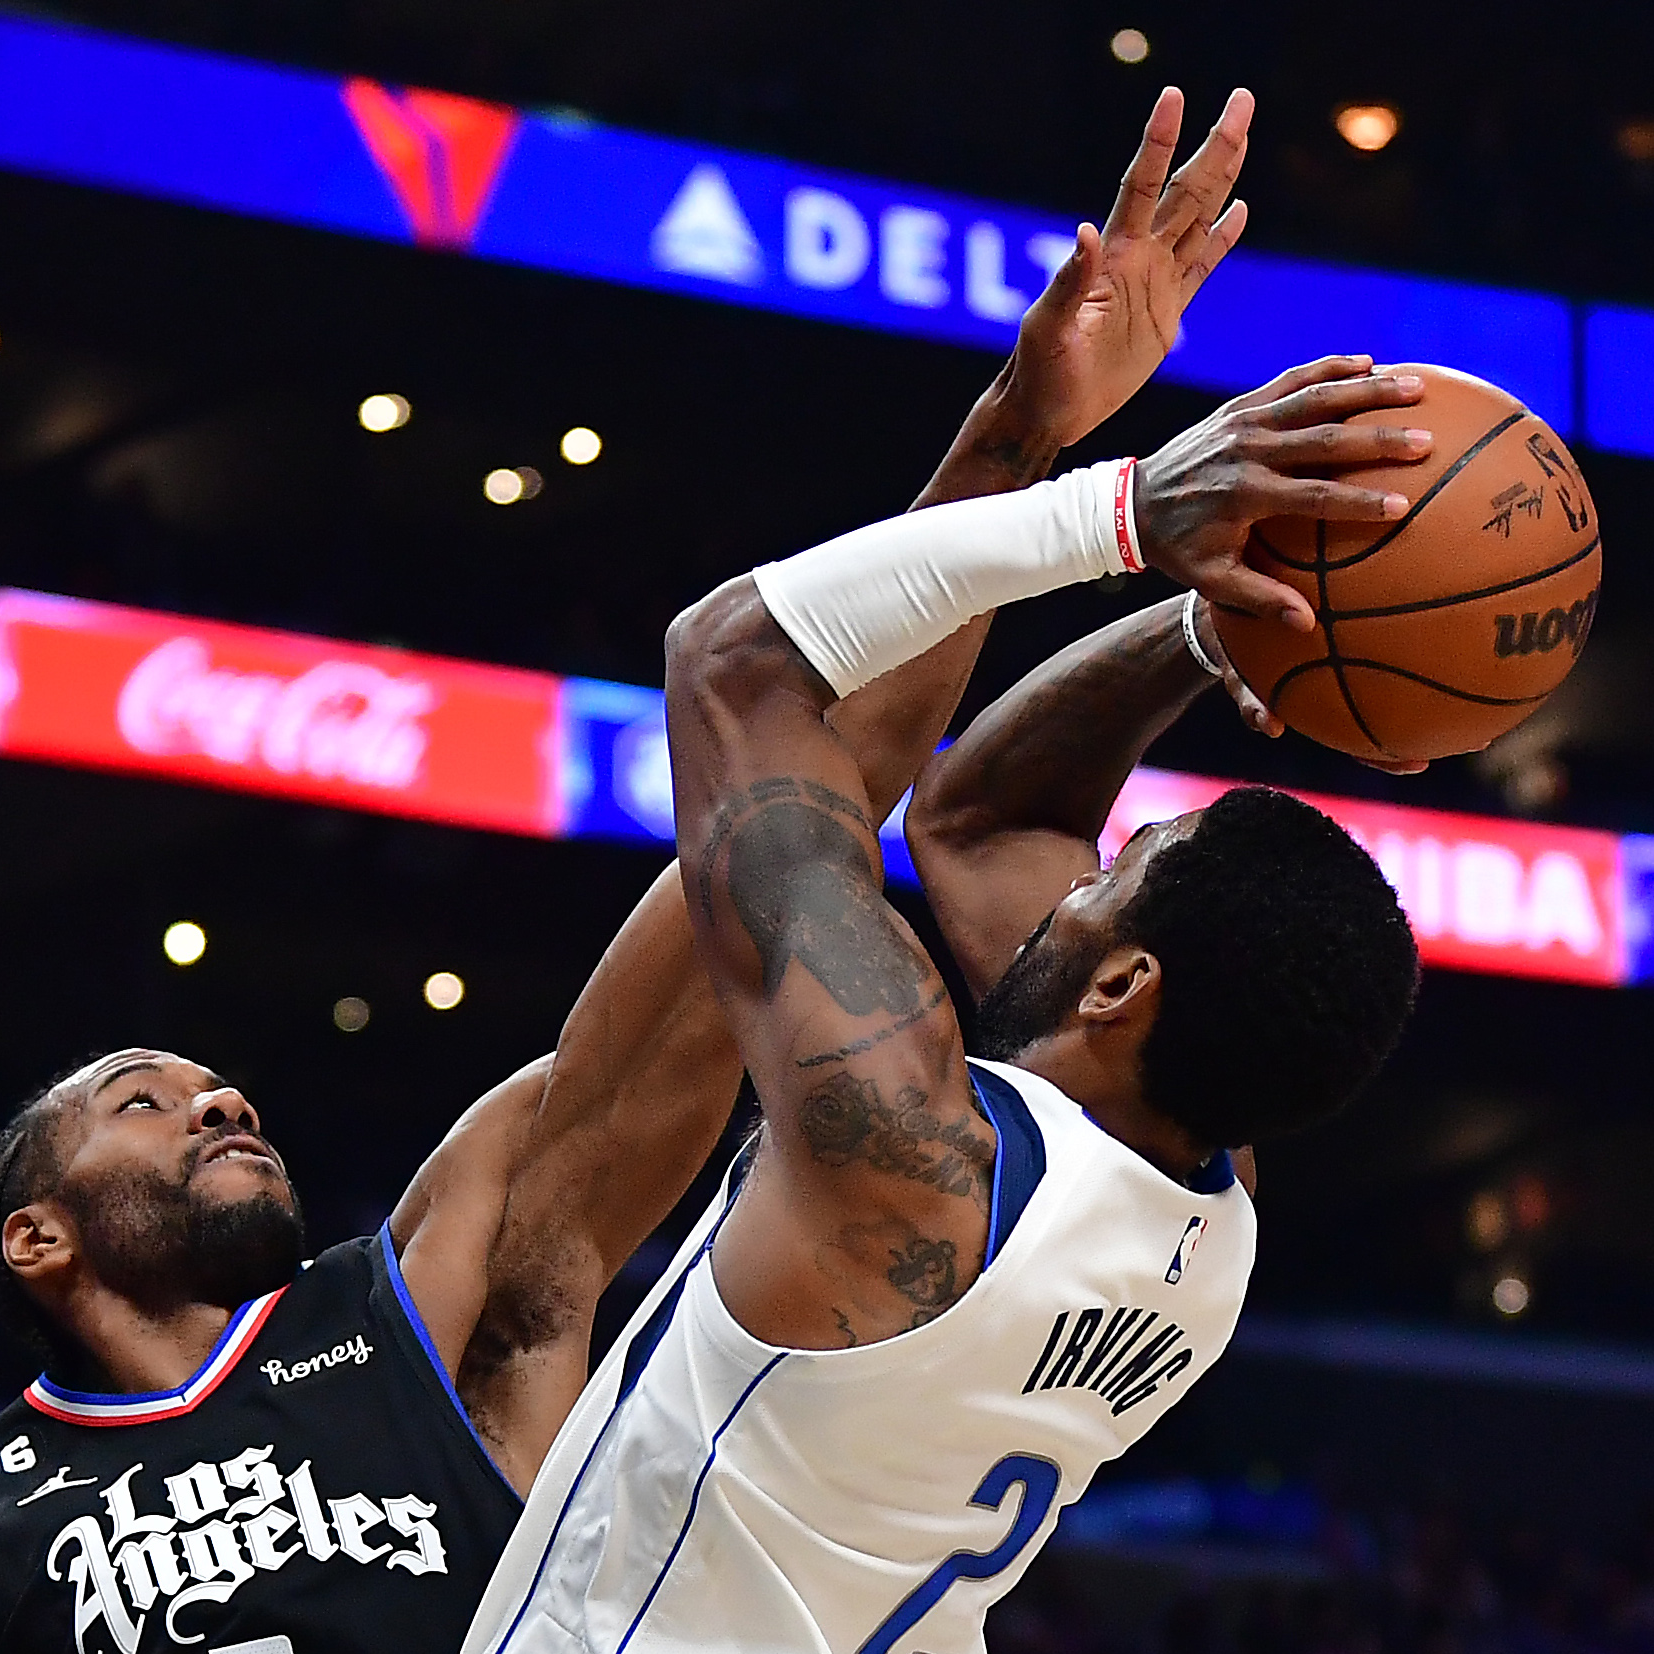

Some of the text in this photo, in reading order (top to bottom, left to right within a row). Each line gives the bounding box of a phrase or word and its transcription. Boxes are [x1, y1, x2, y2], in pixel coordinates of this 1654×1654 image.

[783, 186, 1078, 326] DEL
[260, 1334, 374, 1386] honey
[1021, 1306, 1194, 1418] IRVING
[0, 1434, 38, 1474] 6
[98, 1443, 286, 1545] Los
